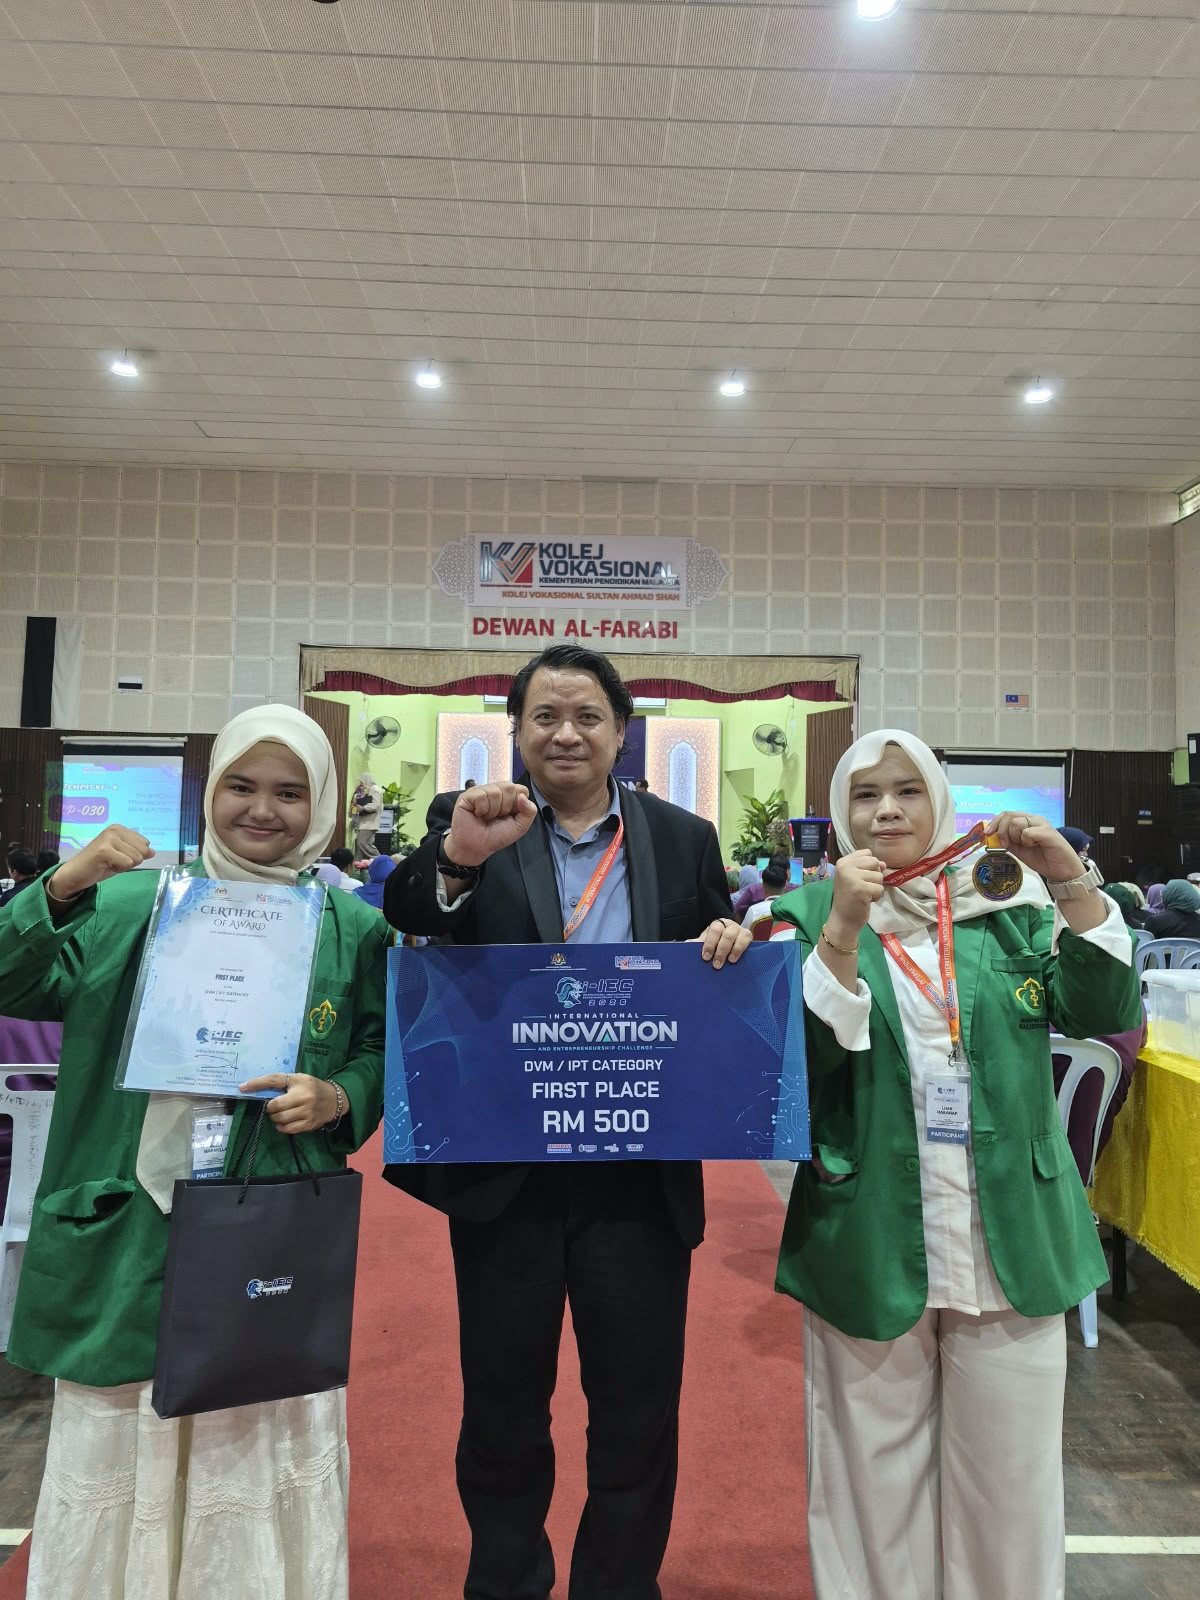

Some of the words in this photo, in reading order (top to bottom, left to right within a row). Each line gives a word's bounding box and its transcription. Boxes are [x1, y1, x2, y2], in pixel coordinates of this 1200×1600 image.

[539, 543, 604, 560] KOLEJ
[539, 560, 679, 578] VOKASIONAL
[538, 577, 593, 585] KEMENTERIAN
[595, 578, 640, 586] PENDIDIKAN
[502, 591, 528, 599] KOLEJ
[529, 591, 584, 600] VOKASIONAL
[586, 592, 619, 600] SULTAN
[620, 593, 655, 601] AHMAD
[655, 593, 680, 601] SHAH
[472, 617, 554, 637] DEWAN
[564, 619, 678, 639] AL-FARABI
[200, 905, 284, 922] CERTIFICATE
[213, 919, 228, 927] OF
[229, 920, 266, 931] AWARD
[512, 1021, 678, 1043] INNOVATION
[524, 1060, 553, 1072] DVM
[557, 1060, 564, 1071] /
[568, 1060, 588, 1071] IPT
[592, 1059, 663, 1071] CATEGORY
[532, 1081, 589, 1099] FIRST
[595, 1081, 660, 1098] PLACE
[543, 1110, 585, 1133] RM
[594, 1109, 649, 1133] 500
[930, 1131, 965, 1139] PARTICIPANT
